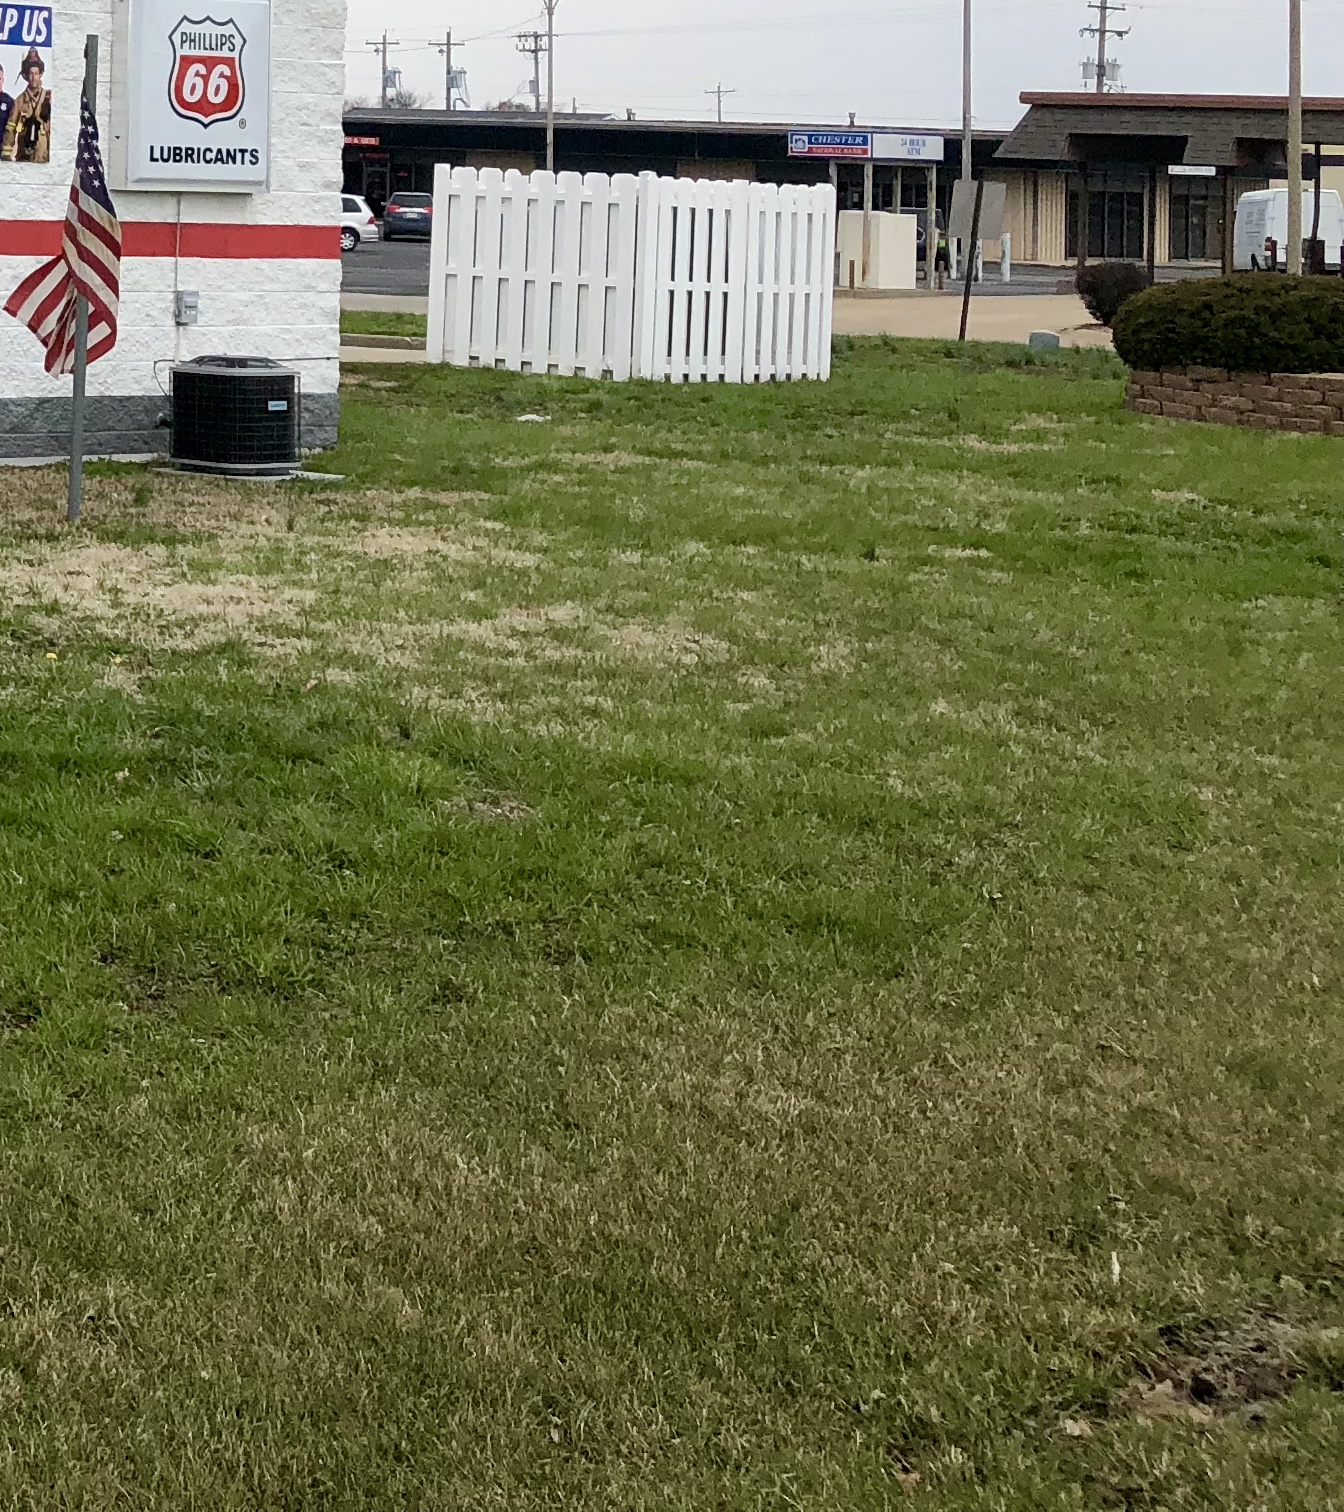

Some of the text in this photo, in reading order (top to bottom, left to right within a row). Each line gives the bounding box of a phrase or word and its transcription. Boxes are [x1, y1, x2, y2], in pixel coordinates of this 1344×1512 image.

[22, 10, 49, 44] US
[180, 31, 236, 53] PHILLIPS
[182, 62, 232, 104] 66
[811, 135, 864, 145] CHESTER
[149, 145, 260, 166] LUBRICANTS
